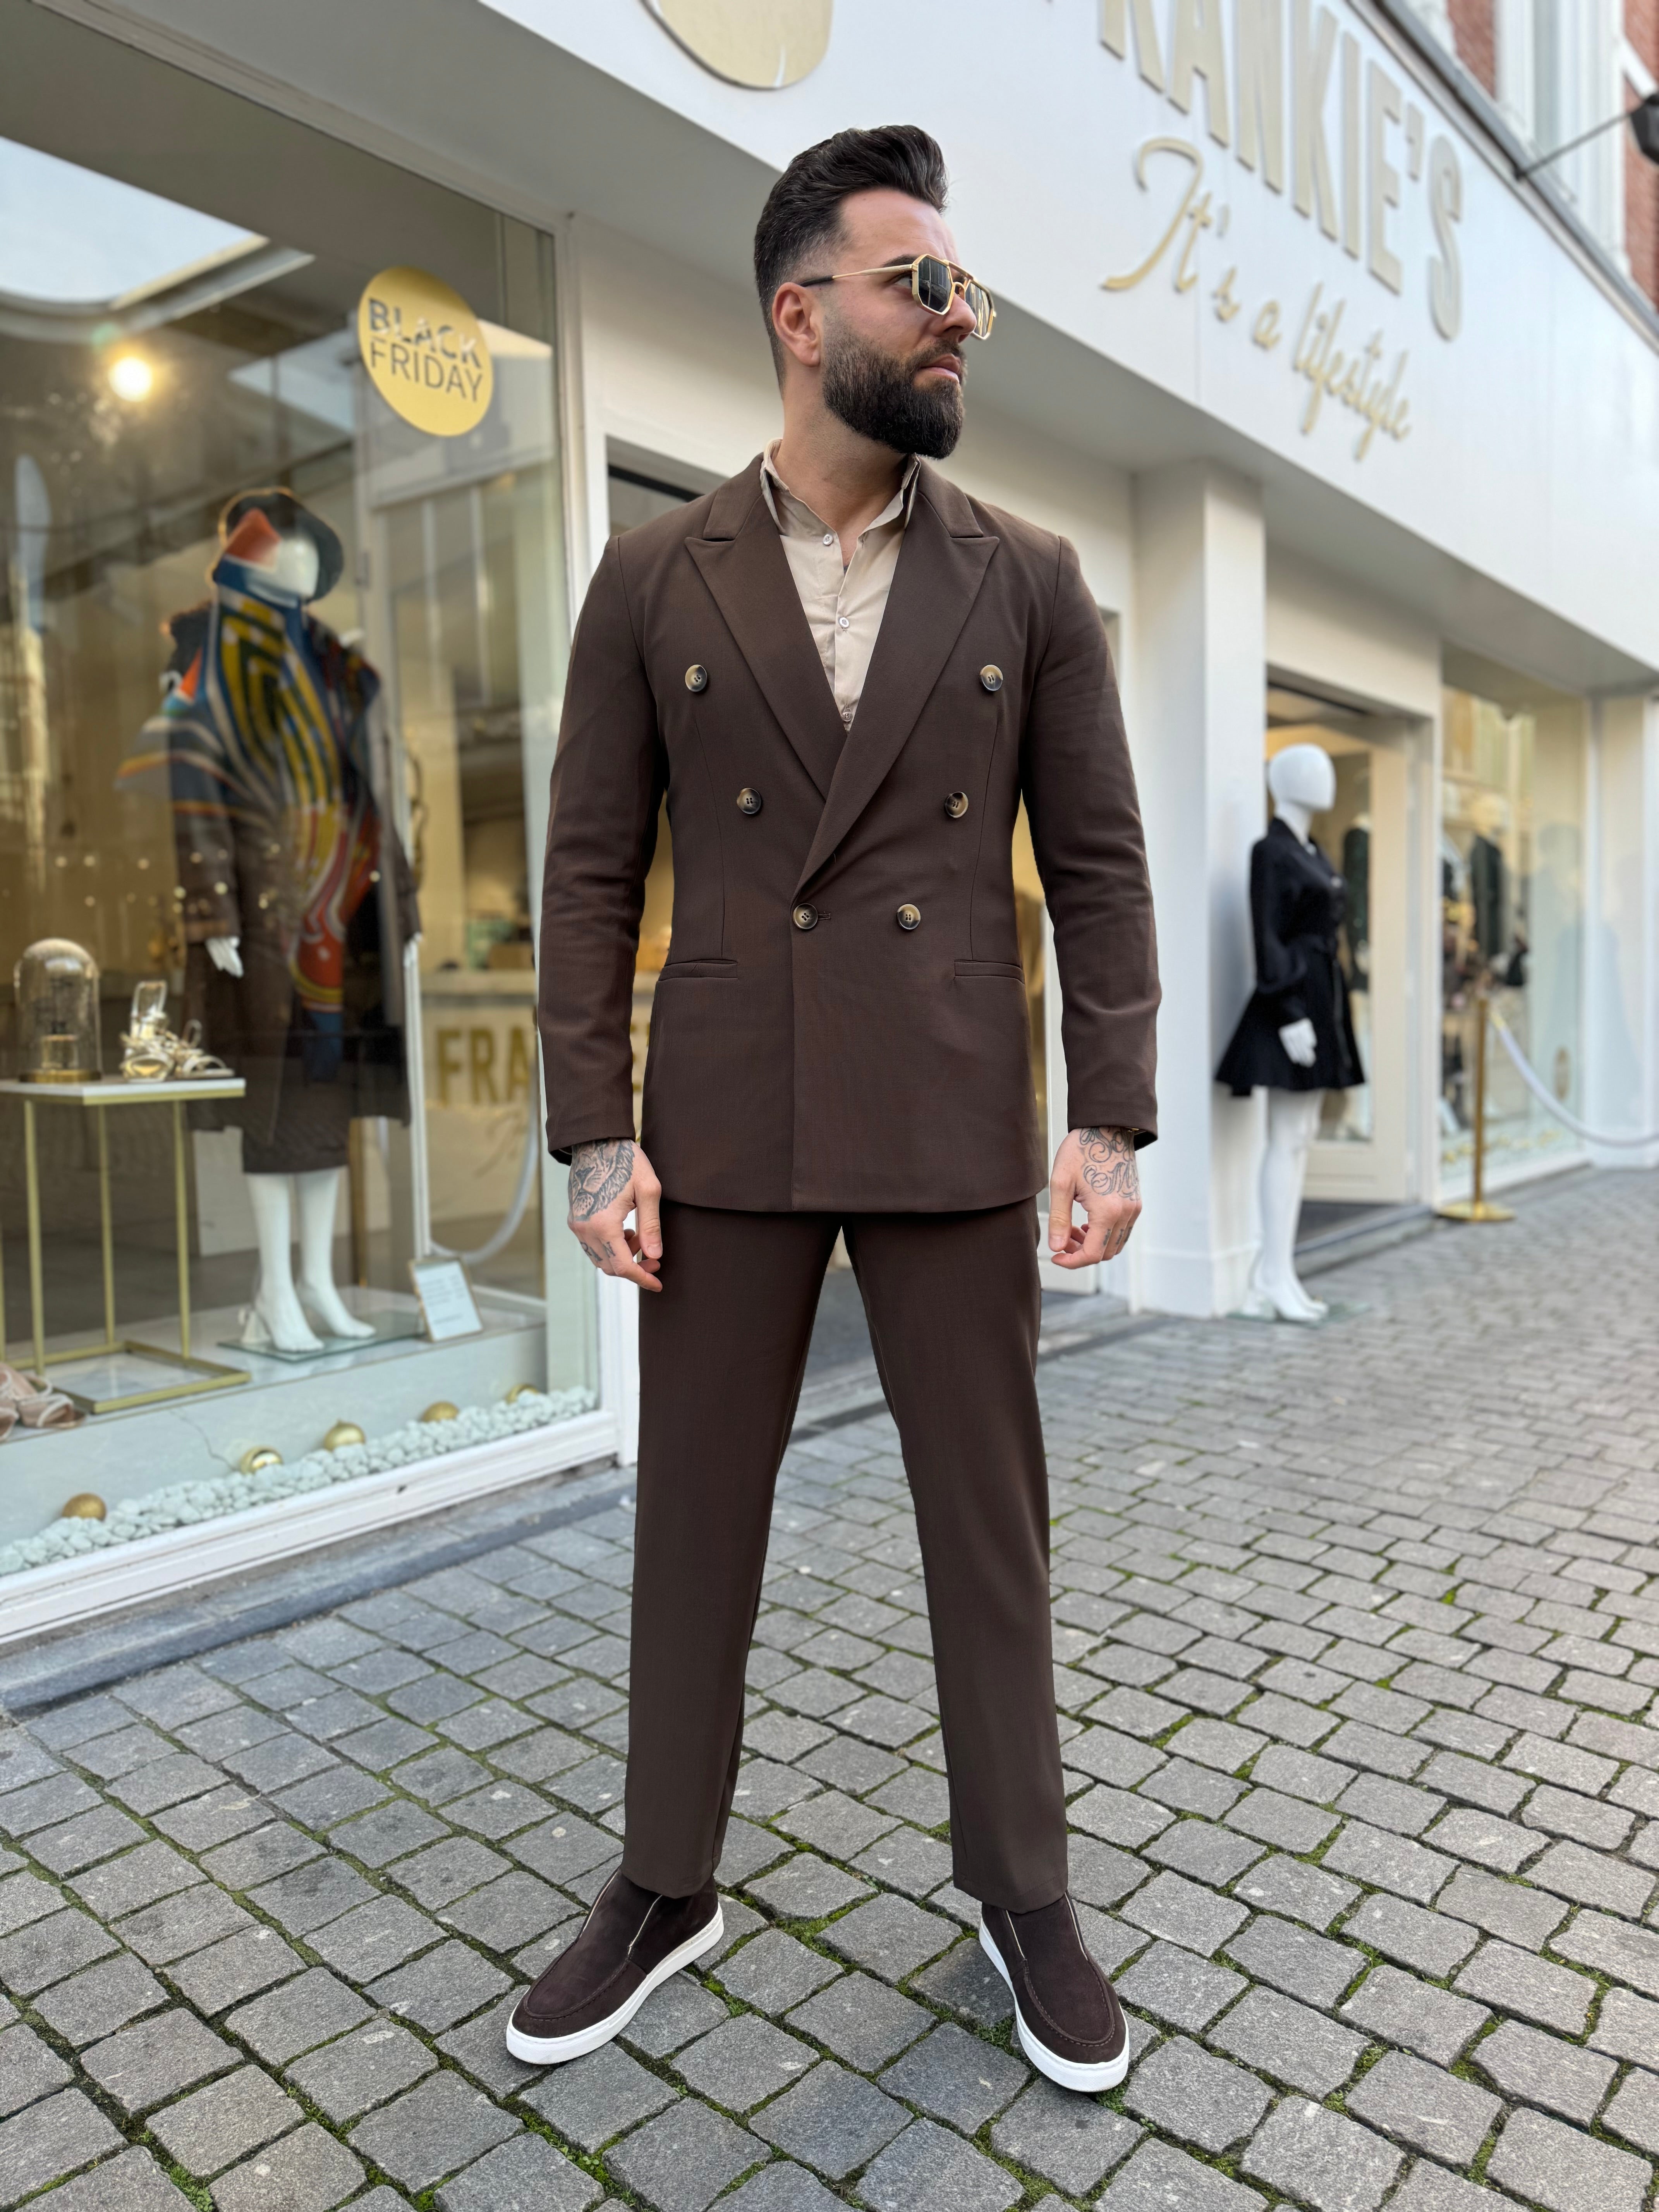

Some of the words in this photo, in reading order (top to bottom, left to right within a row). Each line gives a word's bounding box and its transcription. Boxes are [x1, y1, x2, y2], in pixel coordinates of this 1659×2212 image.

[369, 297, 482, 369] BLACK
[1100, 136, 1241, 323] It's
[1251, 300, 1283, 351] a
[1292, 280, 1413, 464] lifestyle
[370, 336, 483, 403] FRIDAY
